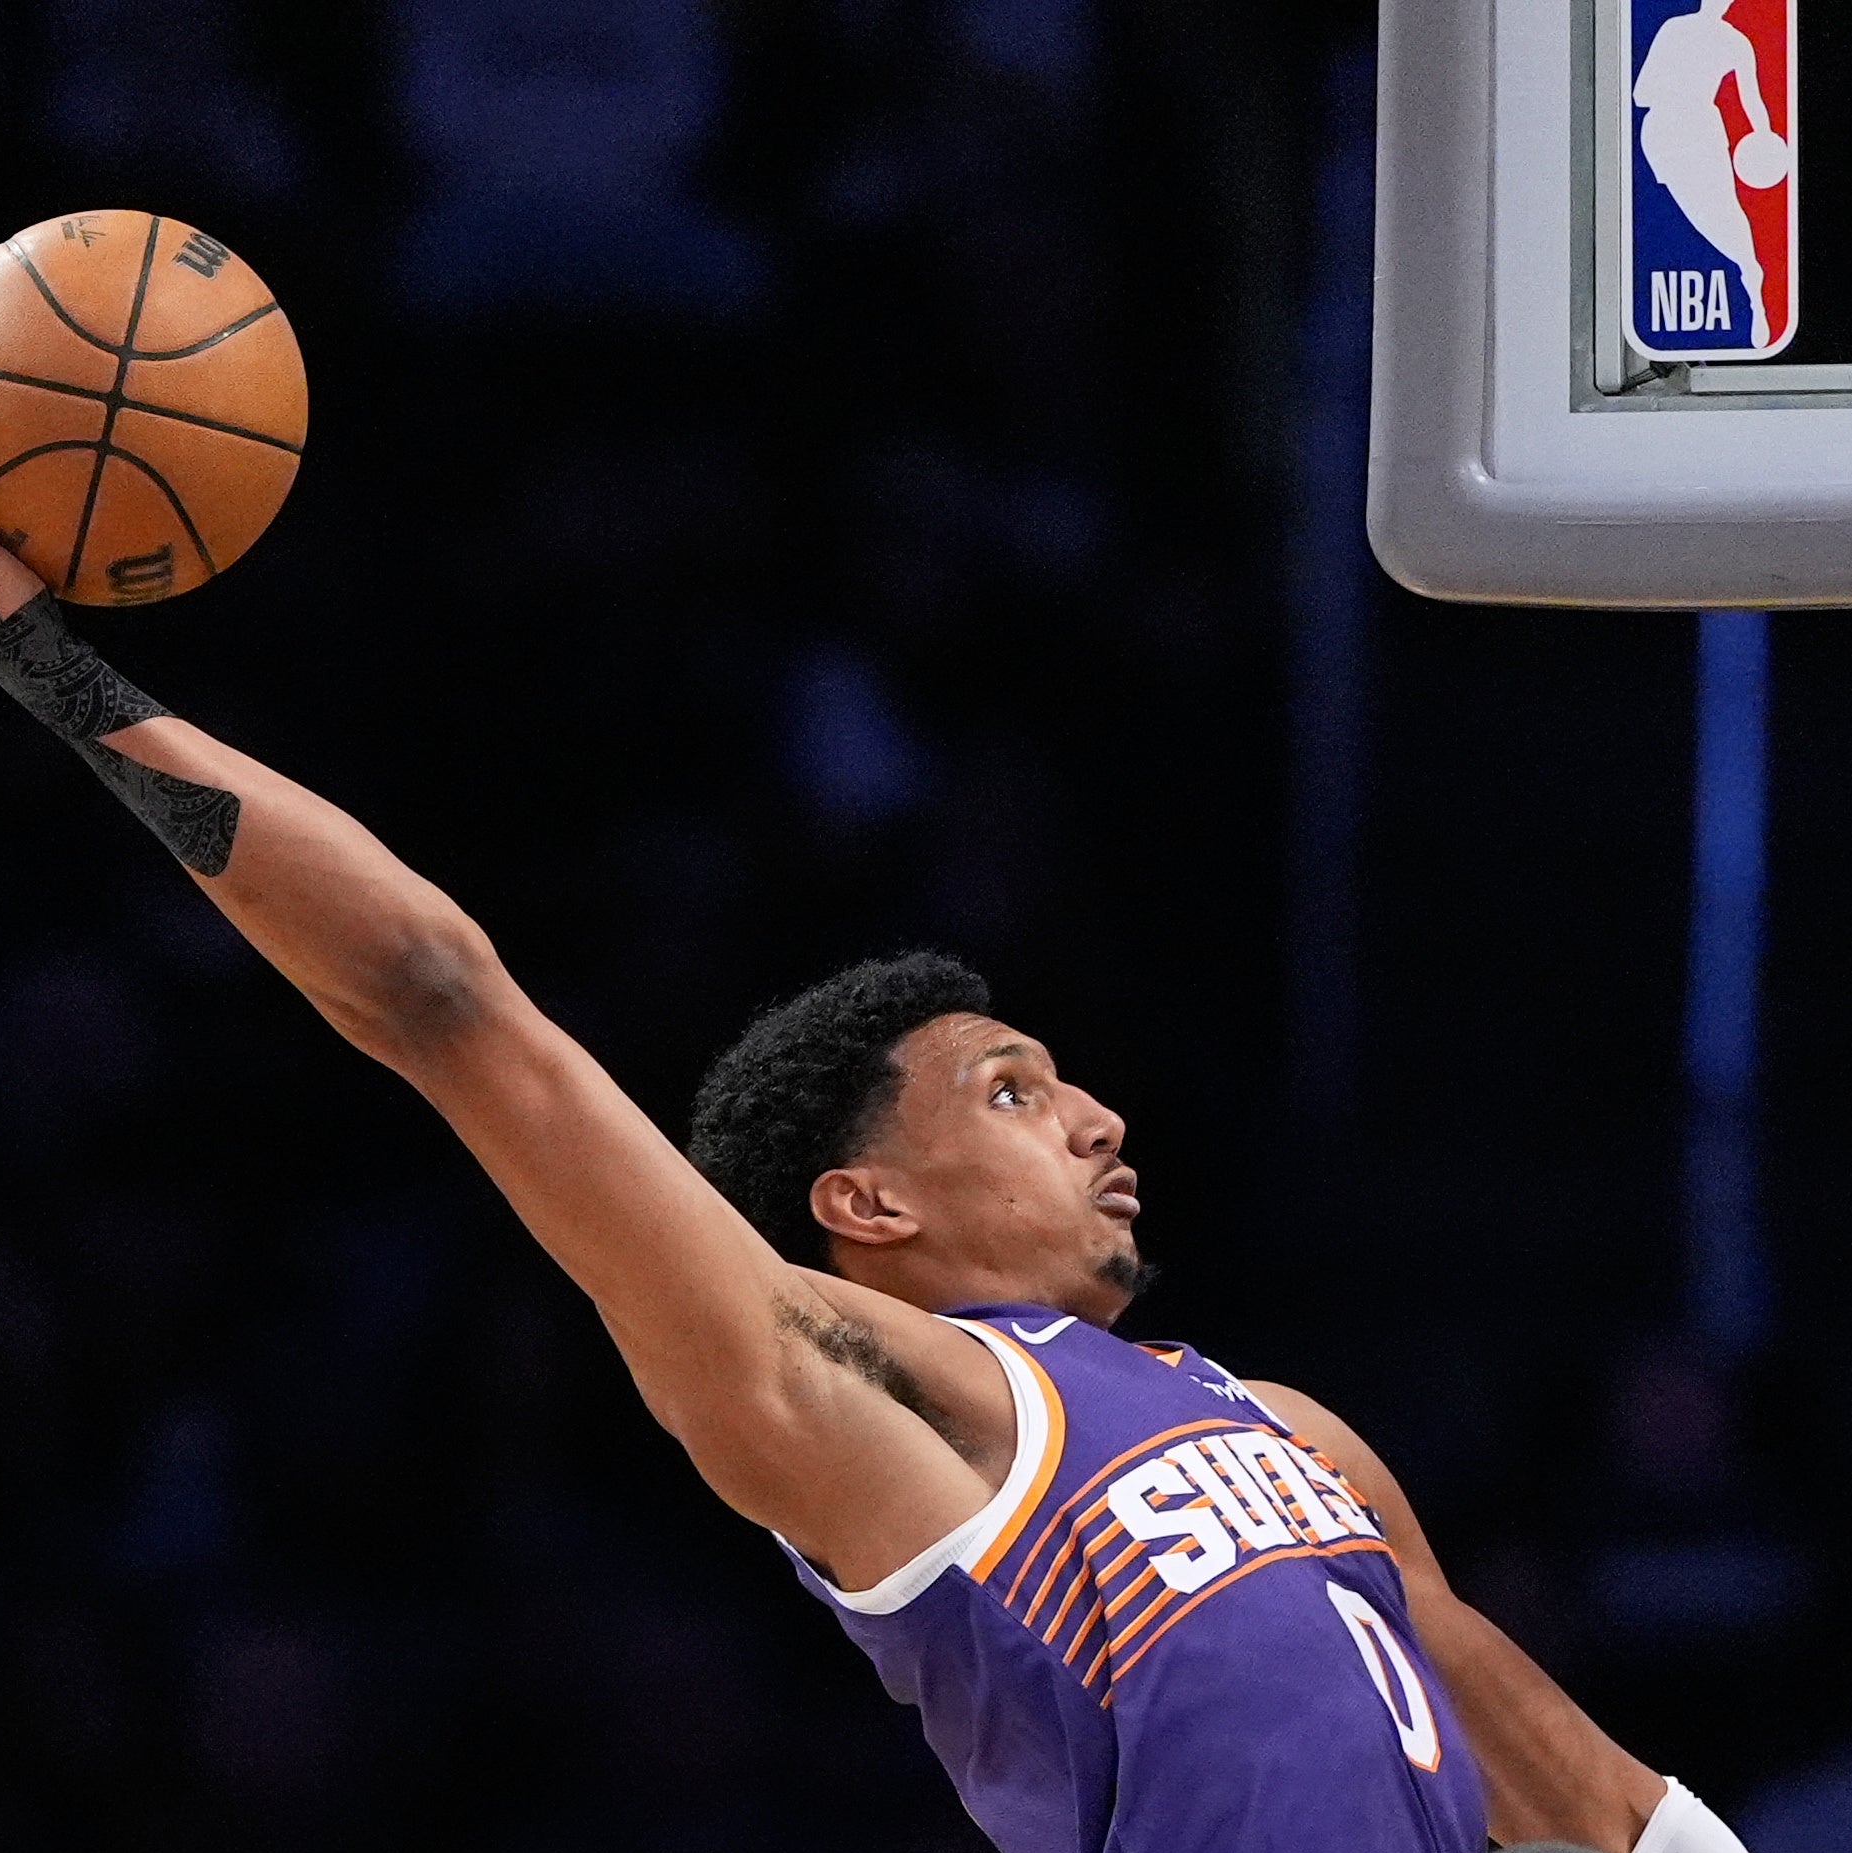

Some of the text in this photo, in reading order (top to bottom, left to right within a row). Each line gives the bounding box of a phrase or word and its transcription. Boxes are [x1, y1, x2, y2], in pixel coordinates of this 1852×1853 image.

[1651, 270, 1731, 331] NBA
[1107, 1431, 1385, 1594] SUNS
[1326, 1580, 1441, 1774] 0
